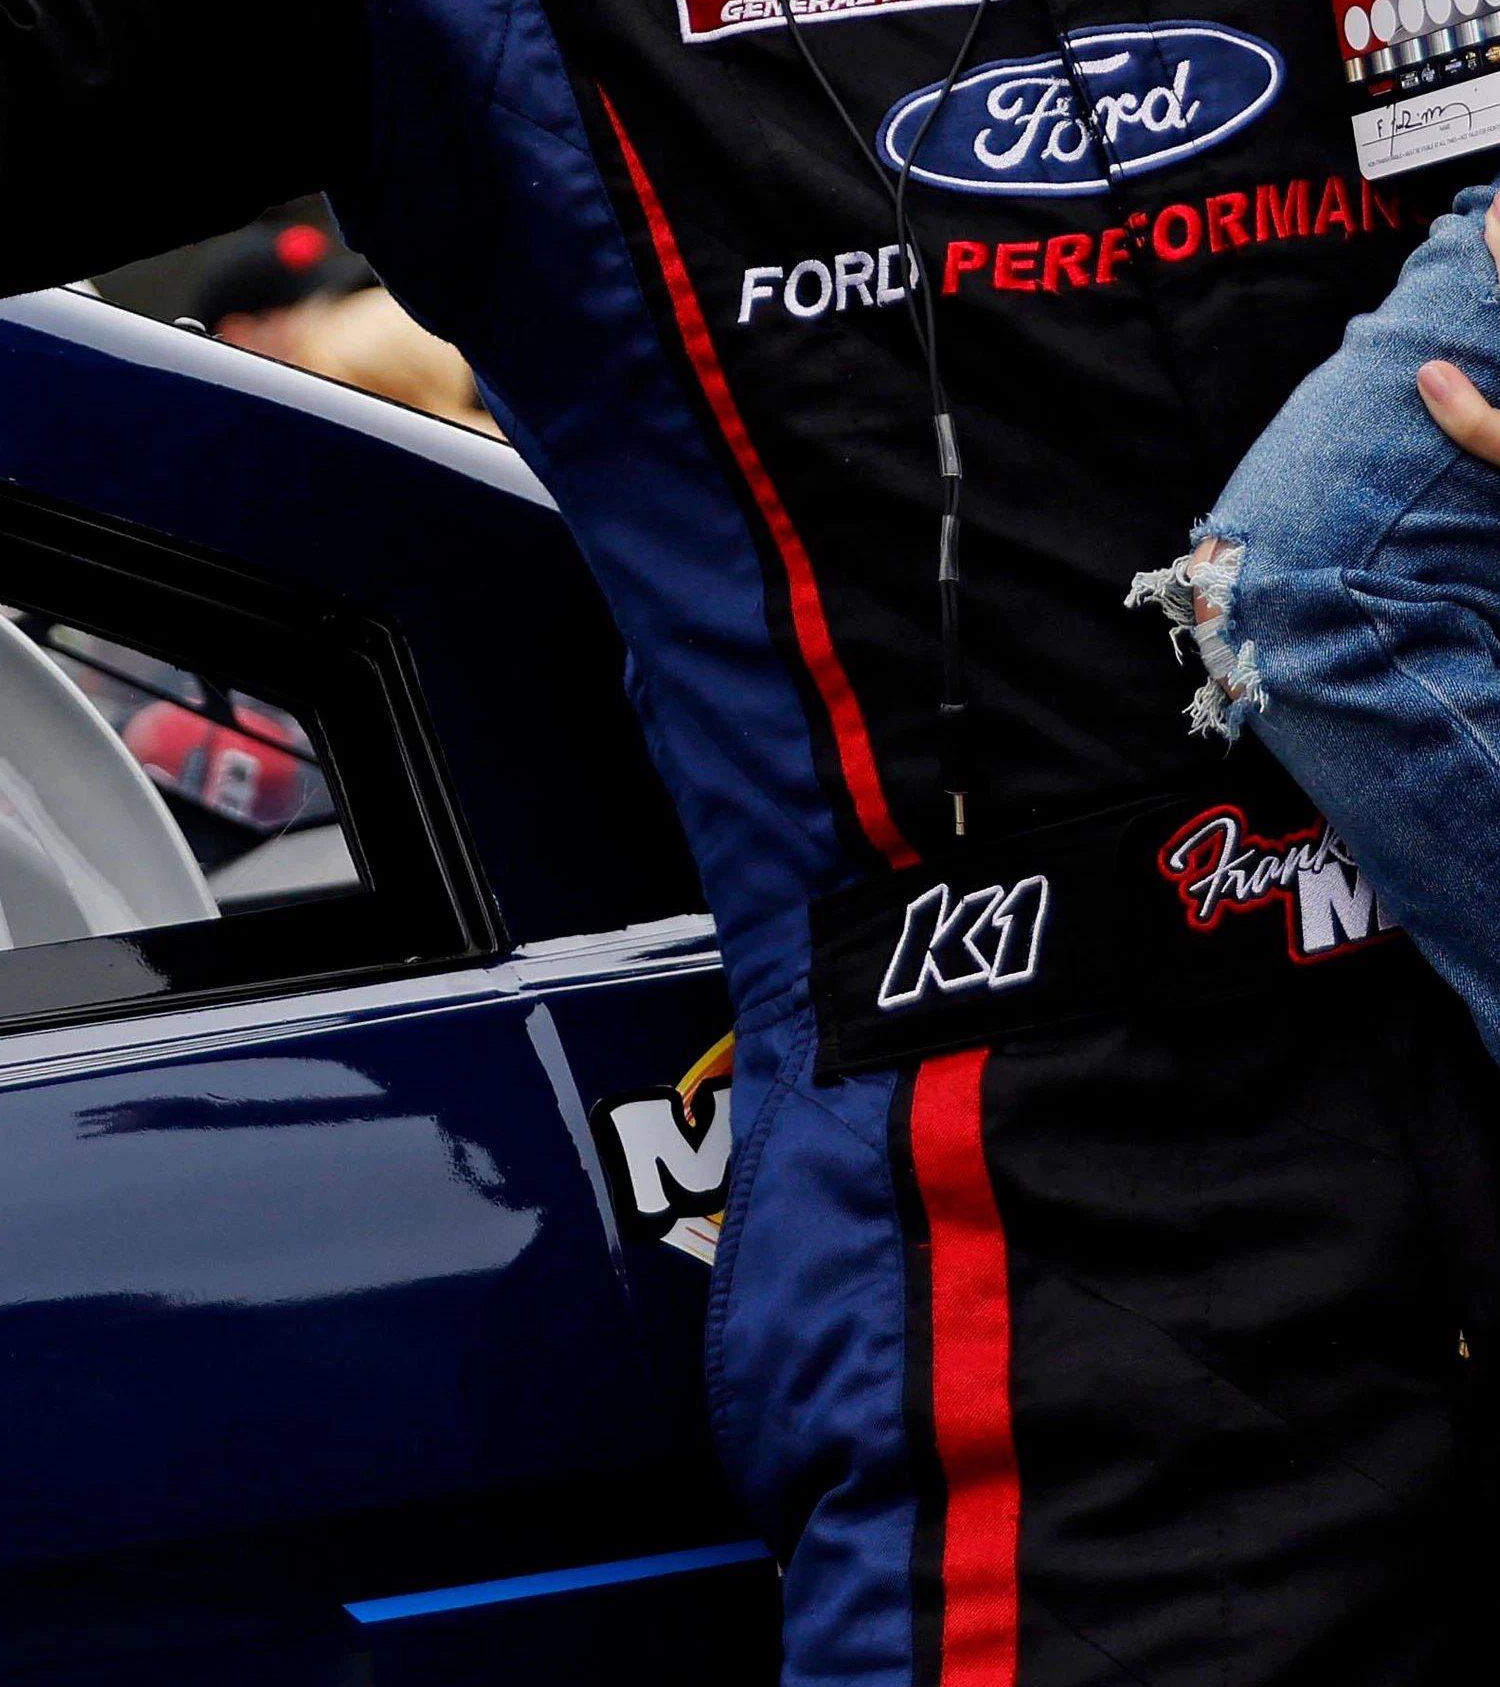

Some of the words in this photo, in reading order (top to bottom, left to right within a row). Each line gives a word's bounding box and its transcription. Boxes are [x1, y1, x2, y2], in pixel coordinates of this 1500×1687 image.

[972, 51, 1201, 169] Ford
[737, 242, 919, 324] FORD
[877, 873, 1051, 1010] K1
